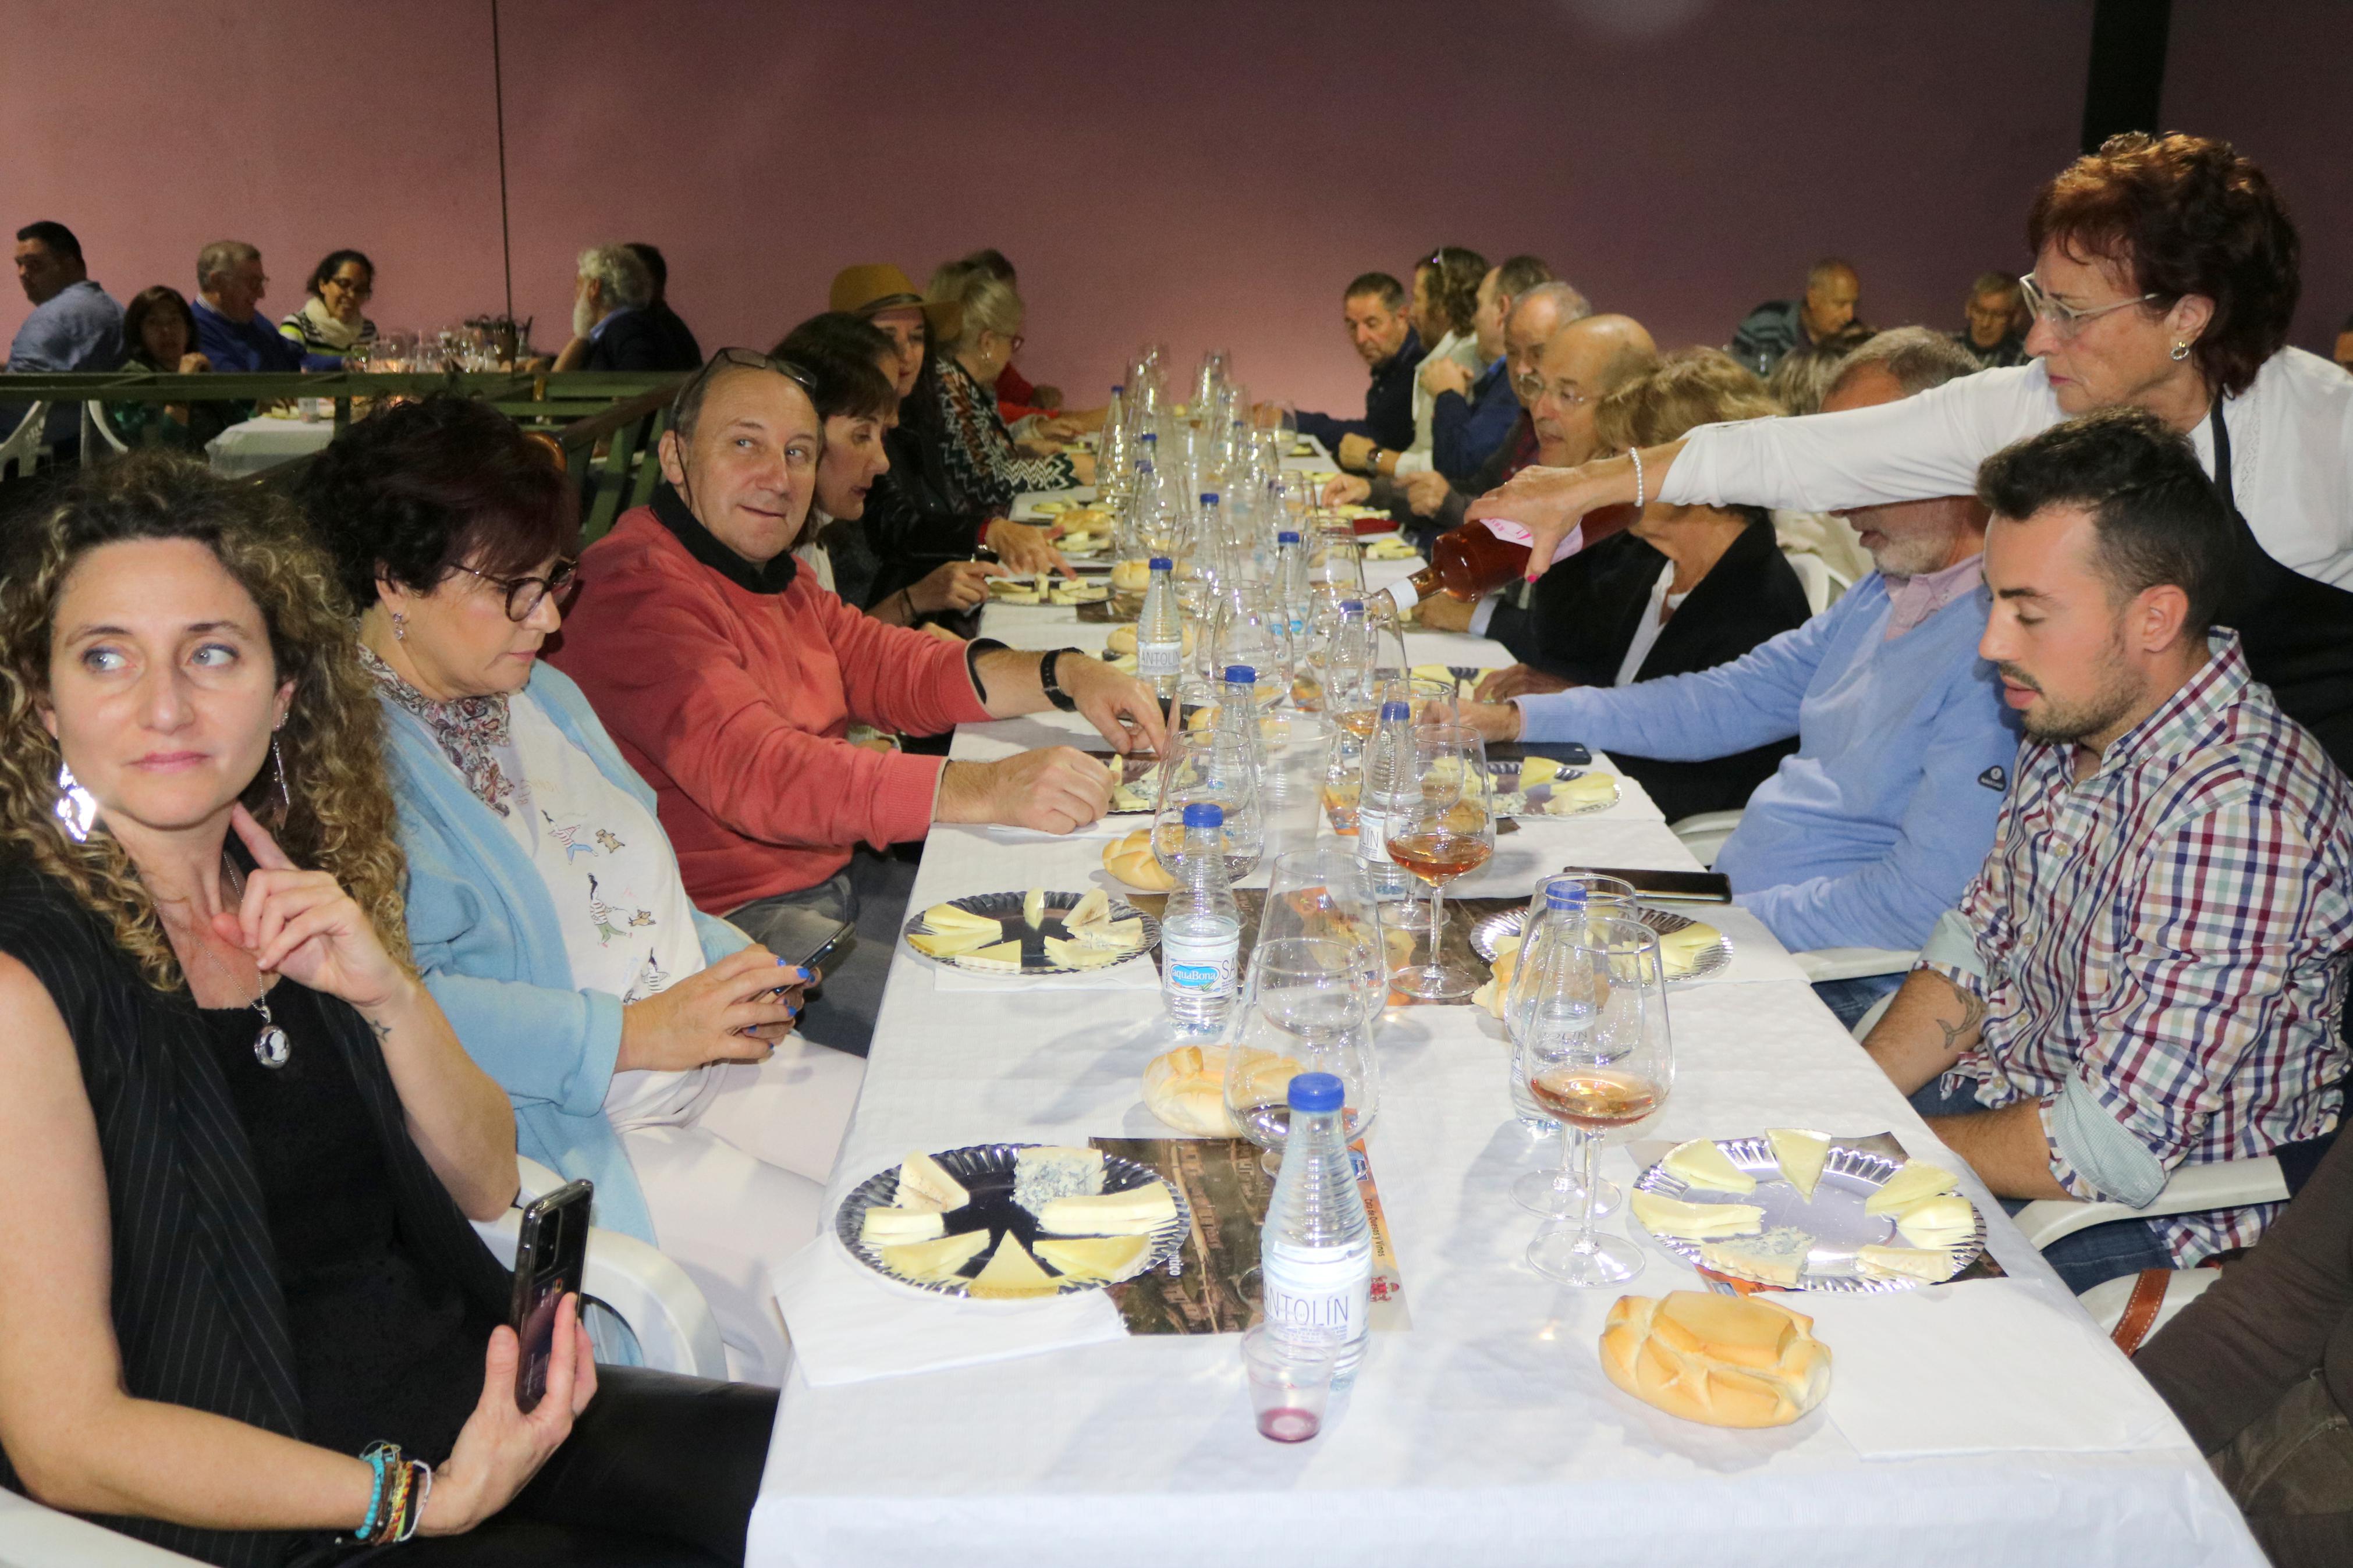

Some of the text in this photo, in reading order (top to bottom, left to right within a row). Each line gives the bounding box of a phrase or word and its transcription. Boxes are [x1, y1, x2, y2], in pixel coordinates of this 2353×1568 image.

[1360, 827, 1379, 848] LÍN
[1172, 968, 1216, 980] aquaBona
[1364, 1199, 1373, 1209] Cata
[1368, 1217, 1380, 1236] Quesos
[1376, 1240, 1385, 1257] Vinos
